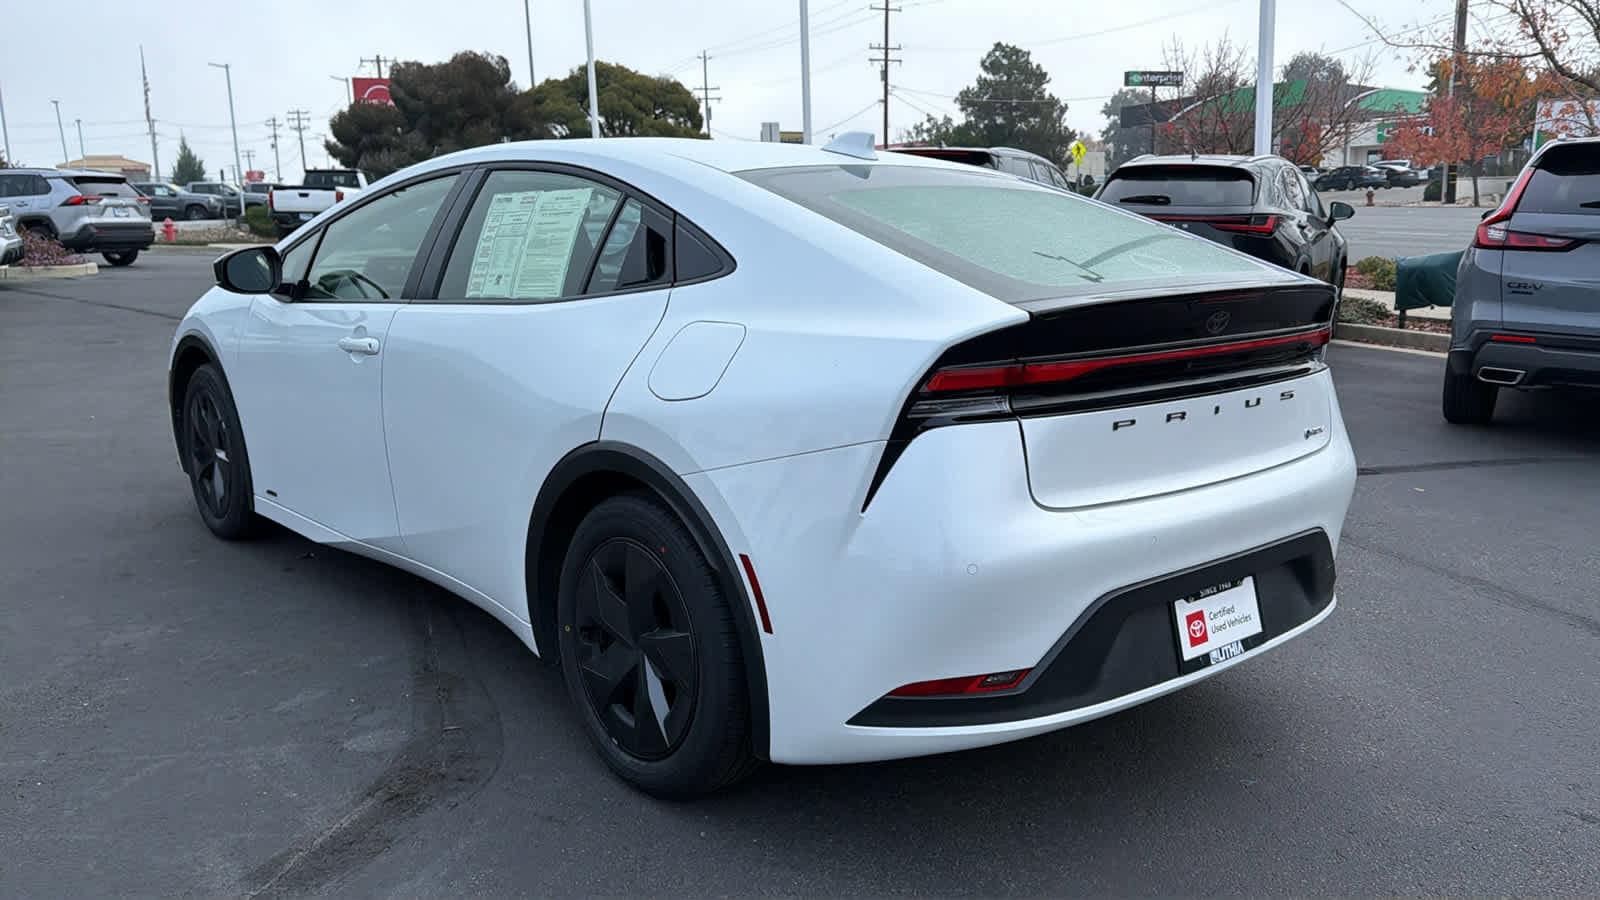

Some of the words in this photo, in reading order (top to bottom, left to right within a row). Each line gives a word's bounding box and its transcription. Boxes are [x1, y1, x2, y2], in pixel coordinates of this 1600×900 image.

[1507, 282, 1543, 290] CR-V
[1112, 390, 1295, 432] PRIUS
[1200, 585, 1217, 597] SINCE
[1209, 605, 1235, 620] Certified
[1212, 622, 1227, 633] Used
[1227, 613, 1251, 627] Vehicles
